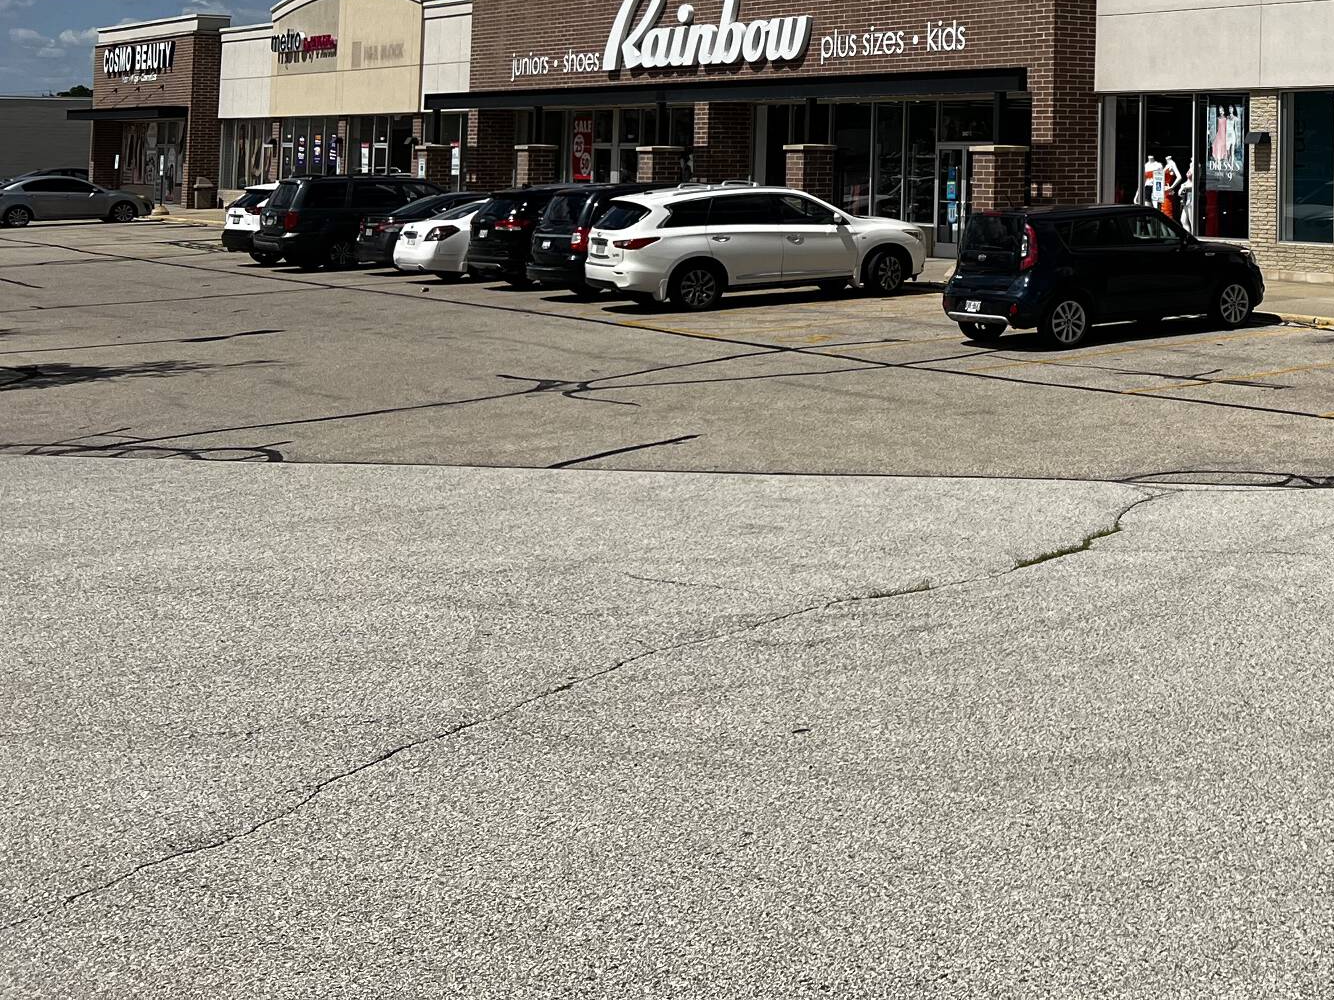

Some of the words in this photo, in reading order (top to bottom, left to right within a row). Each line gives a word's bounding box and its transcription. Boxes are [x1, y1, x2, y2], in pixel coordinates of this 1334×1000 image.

[271, 29, 301, 52] metro
[820, 29, 857, 65] plus
[862, 26, 905, 56] sizes
[927, 20, 966, 52] kids
[135, 41, 172, 70] BEAUTY
[510, 51, 549, 82] juniors
[563, 49, 600, 73] shoes
[574, 120, 592, 133] SALE
